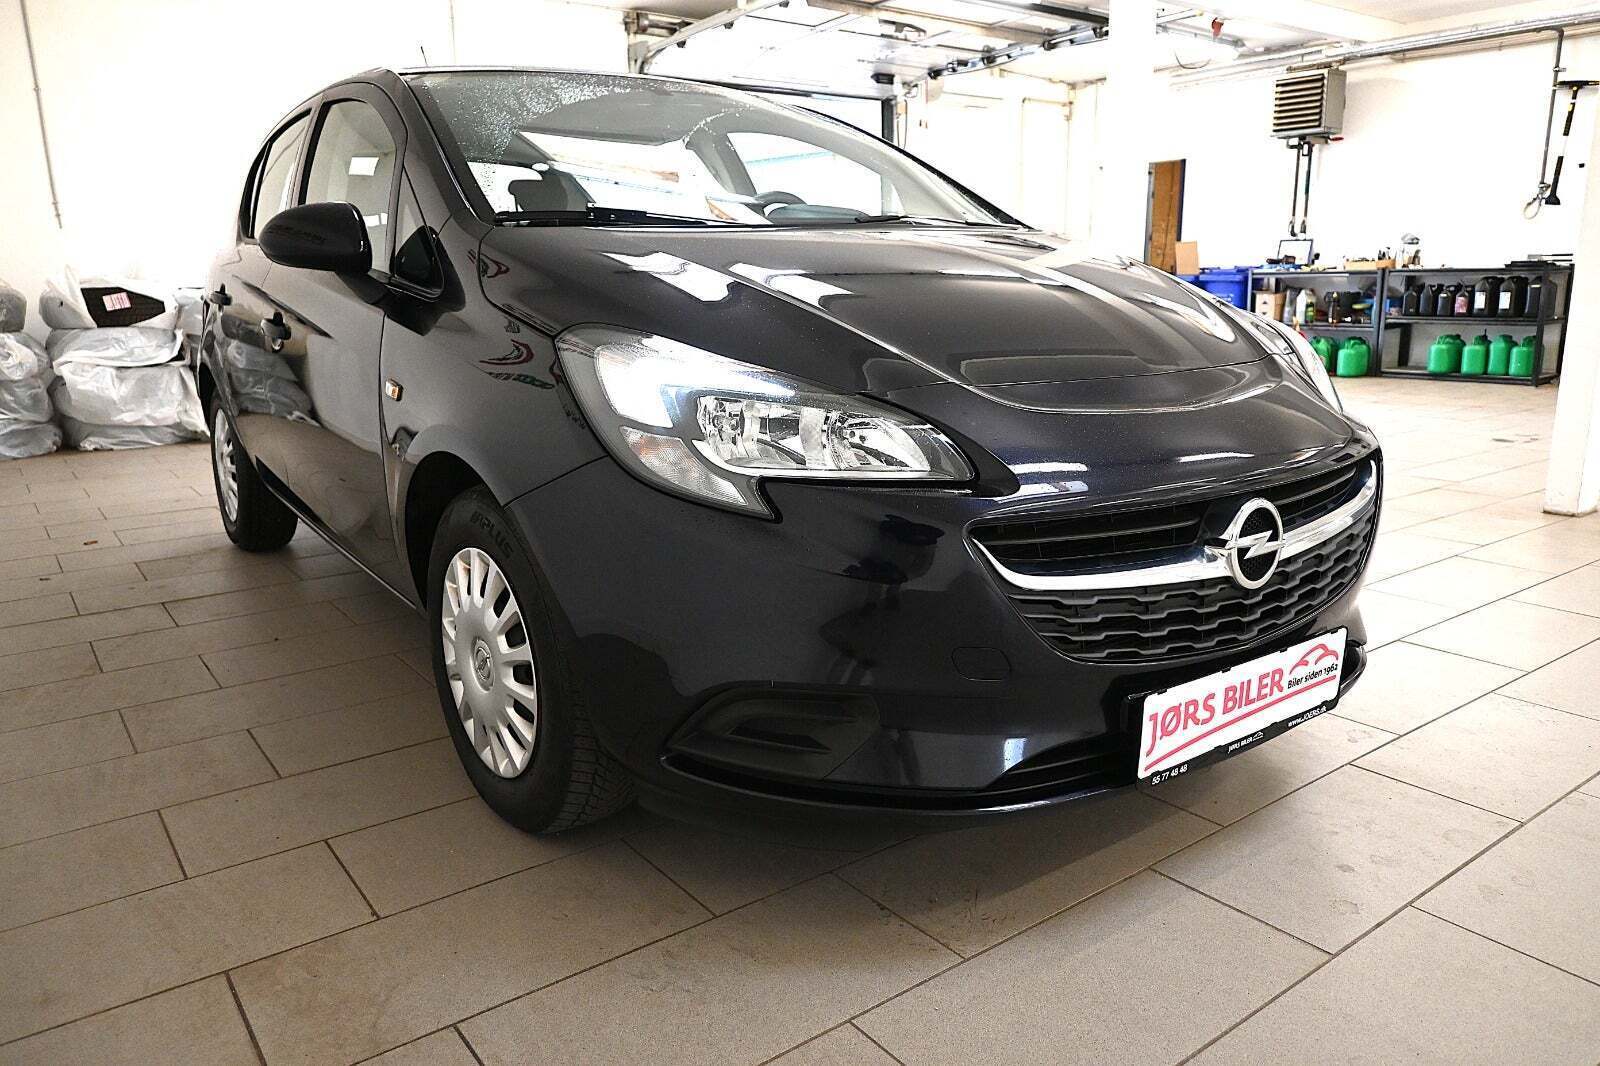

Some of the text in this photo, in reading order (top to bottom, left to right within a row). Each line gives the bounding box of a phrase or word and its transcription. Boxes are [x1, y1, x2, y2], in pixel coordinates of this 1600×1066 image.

[1287, 662, 1338, 689] Biler siden 1962
[1146, 667, 1284, 758] JØRS BILER
[1151, 764, 1188, 785] 55 77 48 48
